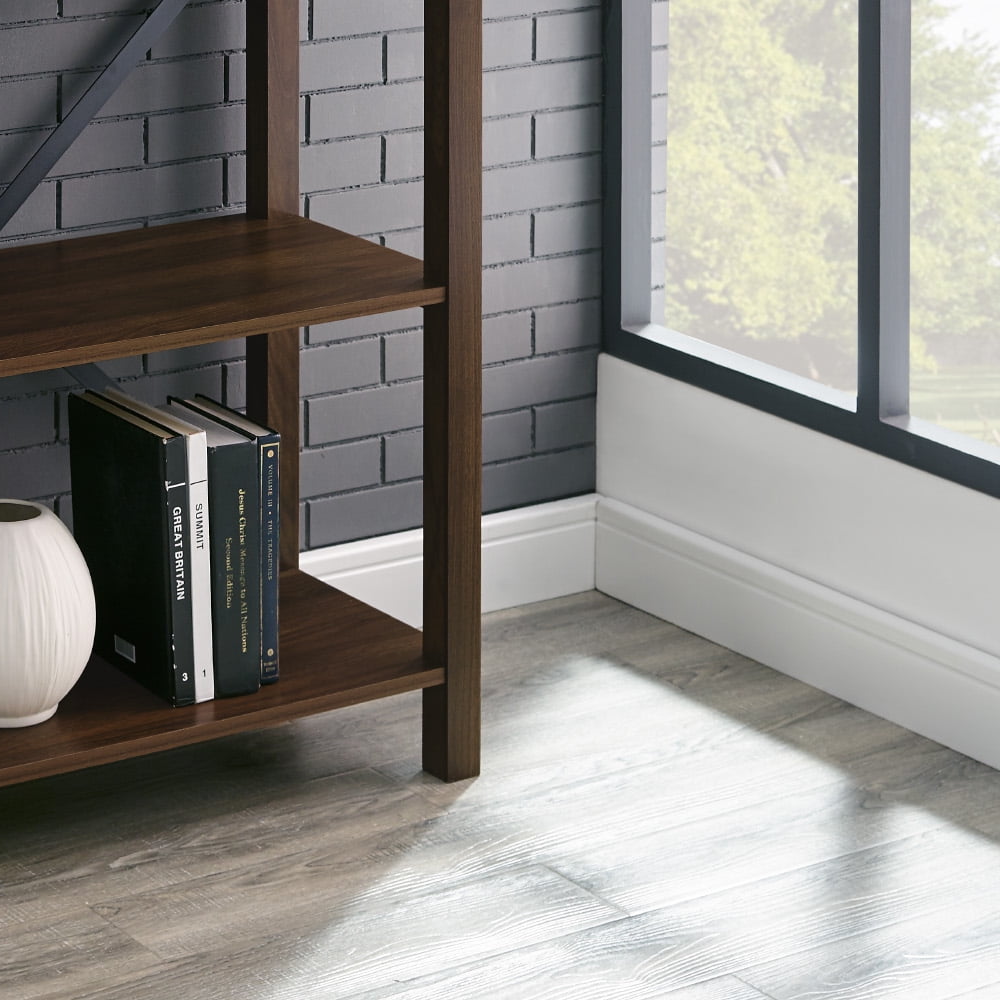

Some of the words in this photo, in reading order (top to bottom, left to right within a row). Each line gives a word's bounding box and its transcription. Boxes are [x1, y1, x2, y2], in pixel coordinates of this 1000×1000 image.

[238, 488, 246, 515] Jesus
[172, 506, 183, 548] GREAT
[195, 503, 204, 550] SUMMIT
[225, 537, 234, 572] Second
[174, 550, 186, 601] BRITAIN
[226, 573, 234, 609] Edition
[240, 588, 247, 599] to
[182, 672, 189, 682] 3
[202, 668, 206, 678] 1
